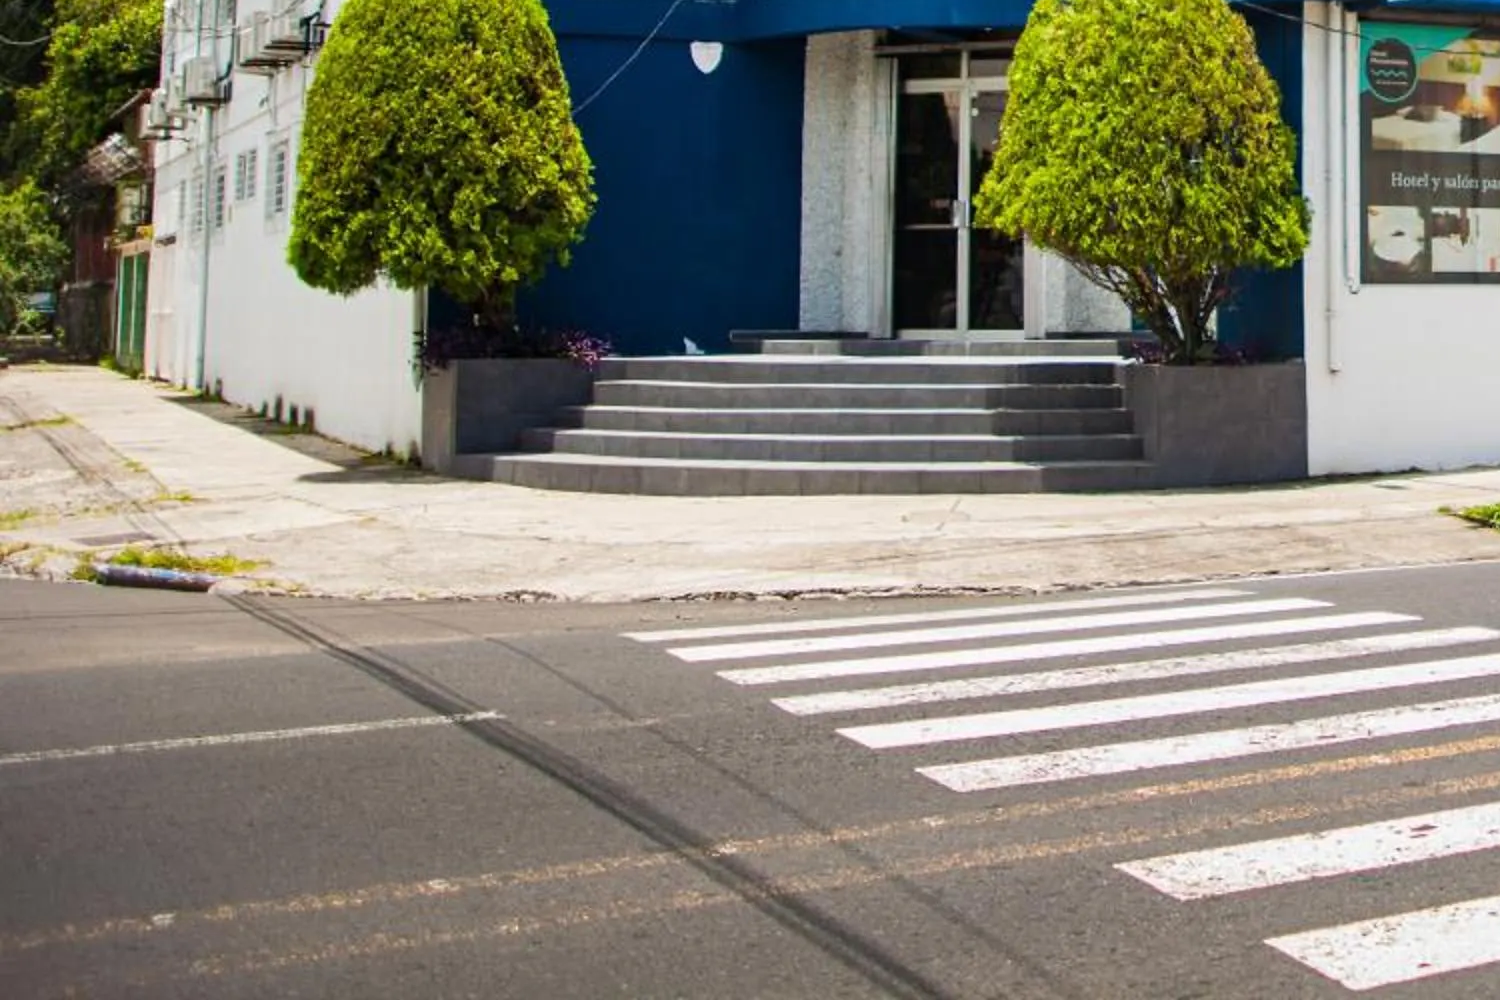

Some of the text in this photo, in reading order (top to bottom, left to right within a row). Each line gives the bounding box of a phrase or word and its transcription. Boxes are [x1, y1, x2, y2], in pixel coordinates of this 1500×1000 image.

[1391, 172, 1429, 188] Hotel
[1432, 177, 1441, 192] y
[1444, 174, 1479, 189] salón
